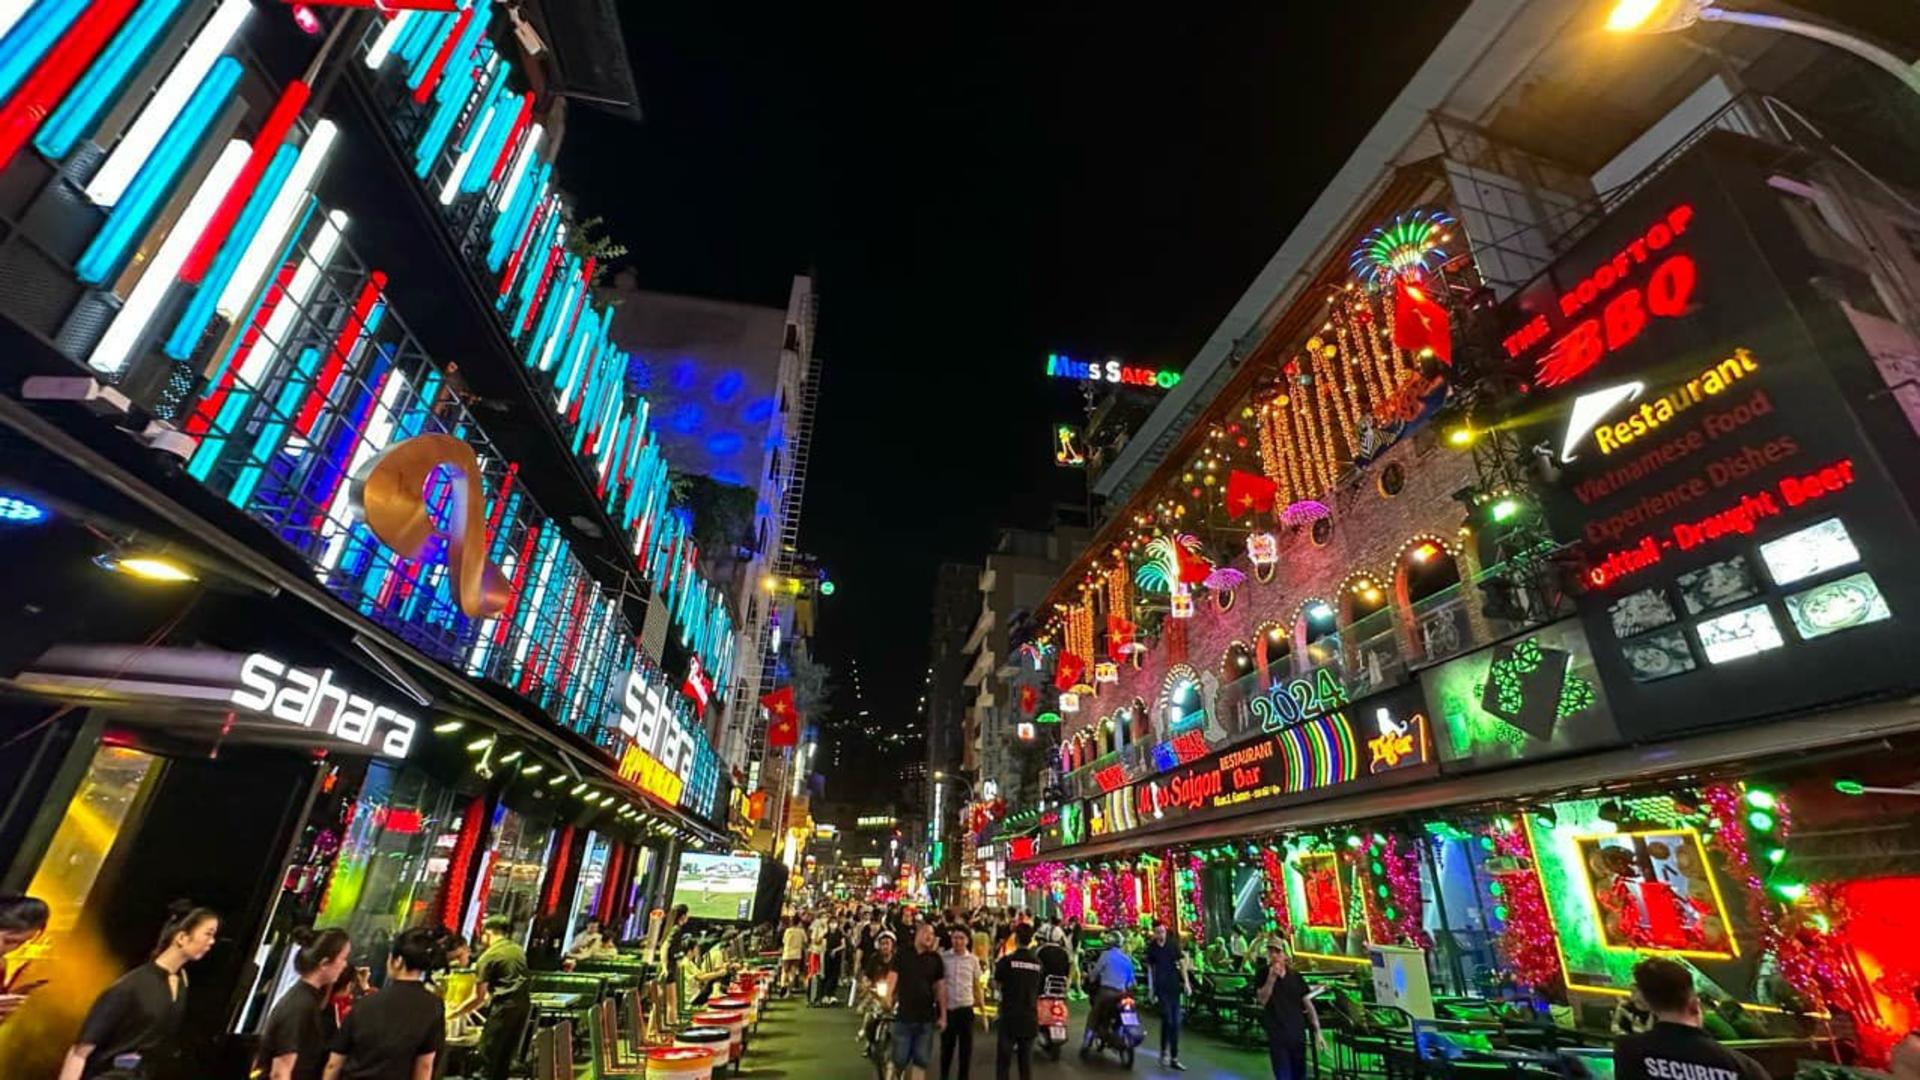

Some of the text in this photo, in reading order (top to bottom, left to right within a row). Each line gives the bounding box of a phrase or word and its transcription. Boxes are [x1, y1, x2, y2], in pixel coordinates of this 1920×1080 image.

[1502, 204, 1694, 358] THE ROOFTOP
[1534, 254, 1697, 389] BBQ
[1573, 390, 1775, 505] Vietnamese Food
[1595, 347, 1758, 455] Restaurant
[1584, 435, 1799, 546] Experience Dishes
[1673, 491, 1780, 551] Draught
[1779, 459, 1854, 507] Beer
[231, 653, 416, 759] sahara
[619, 672, 695, 784] sahara
[1251, 668, 1349, 733] 2024
[1170, 769, 1222, 810] Saigon
[1233, 767, 1260, 789] Bar
[1220, 741, 1273, 771] RESTAURANT
